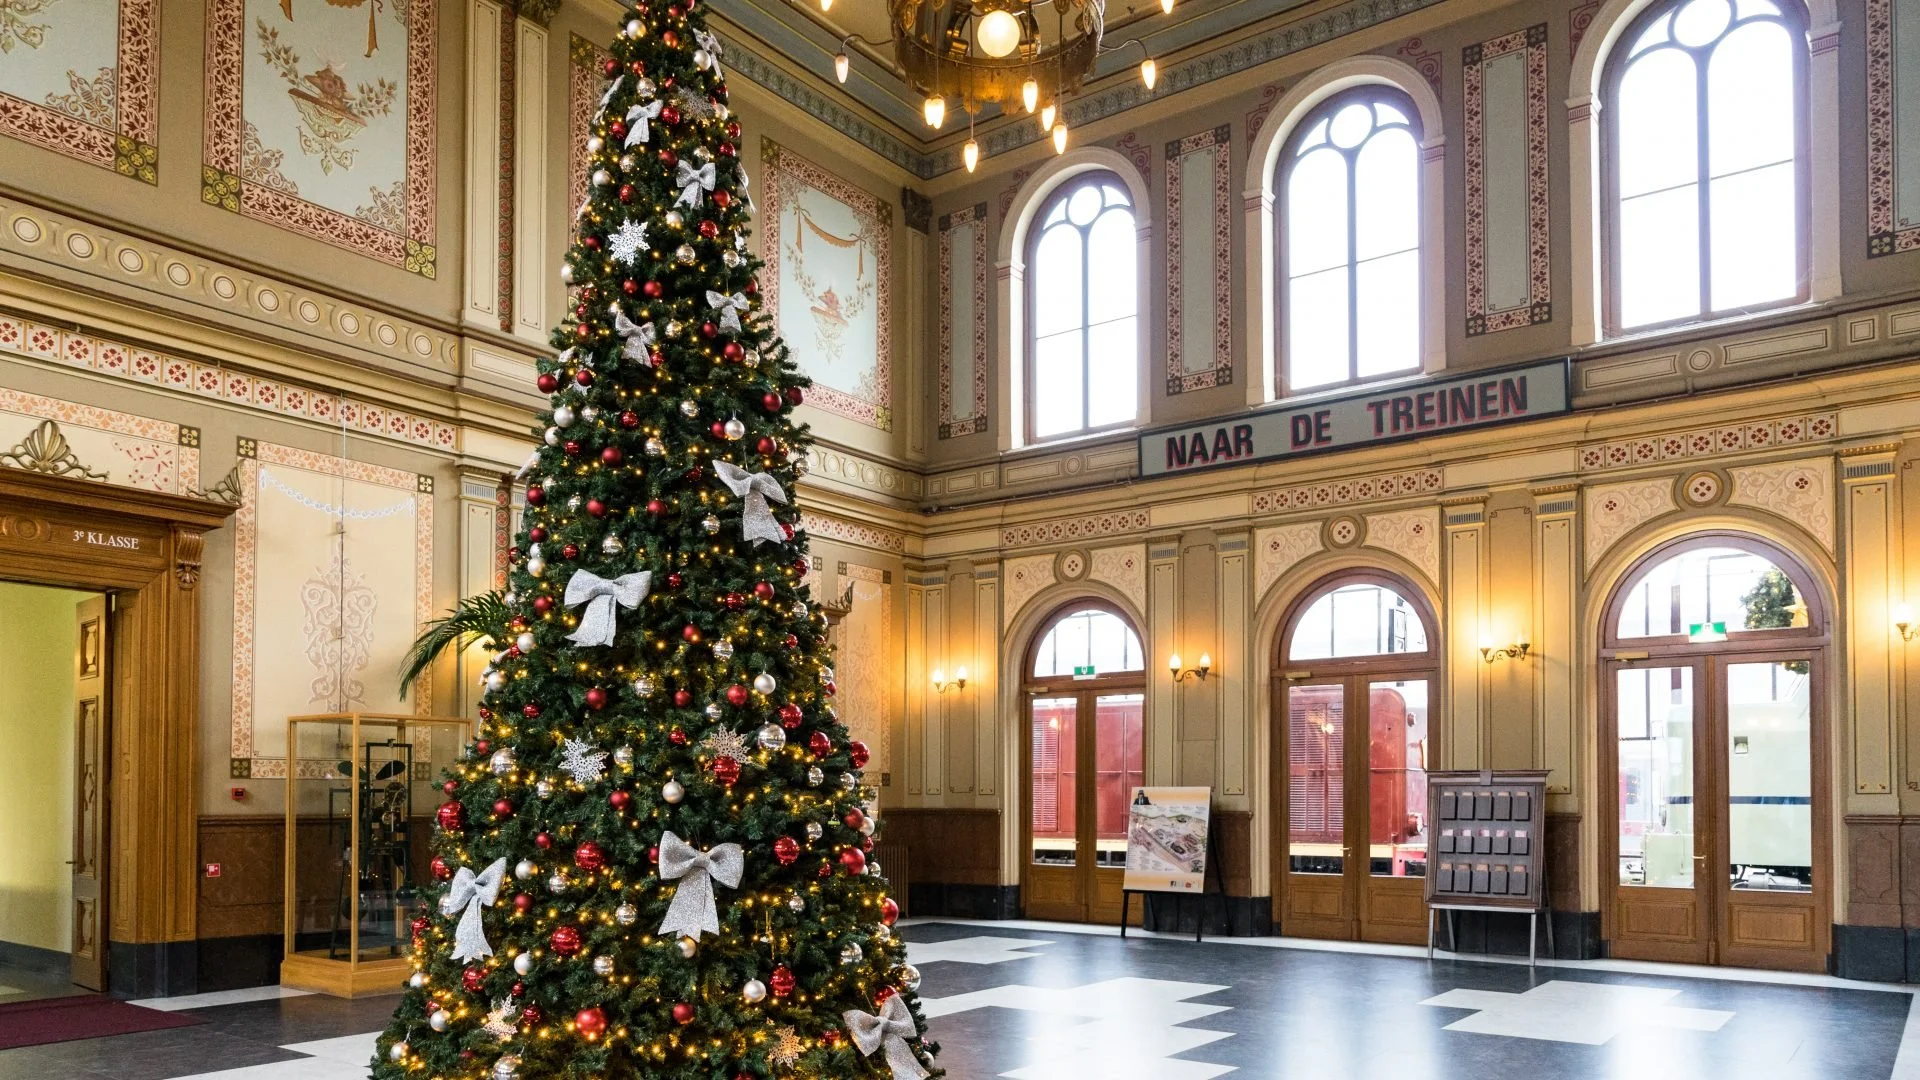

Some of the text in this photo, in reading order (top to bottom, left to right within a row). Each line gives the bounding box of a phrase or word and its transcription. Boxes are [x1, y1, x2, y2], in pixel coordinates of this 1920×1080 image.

[1166, 375, 1528, 470] NAAR DE TREINEN
[87, 531, 140, 550] KLASSE
